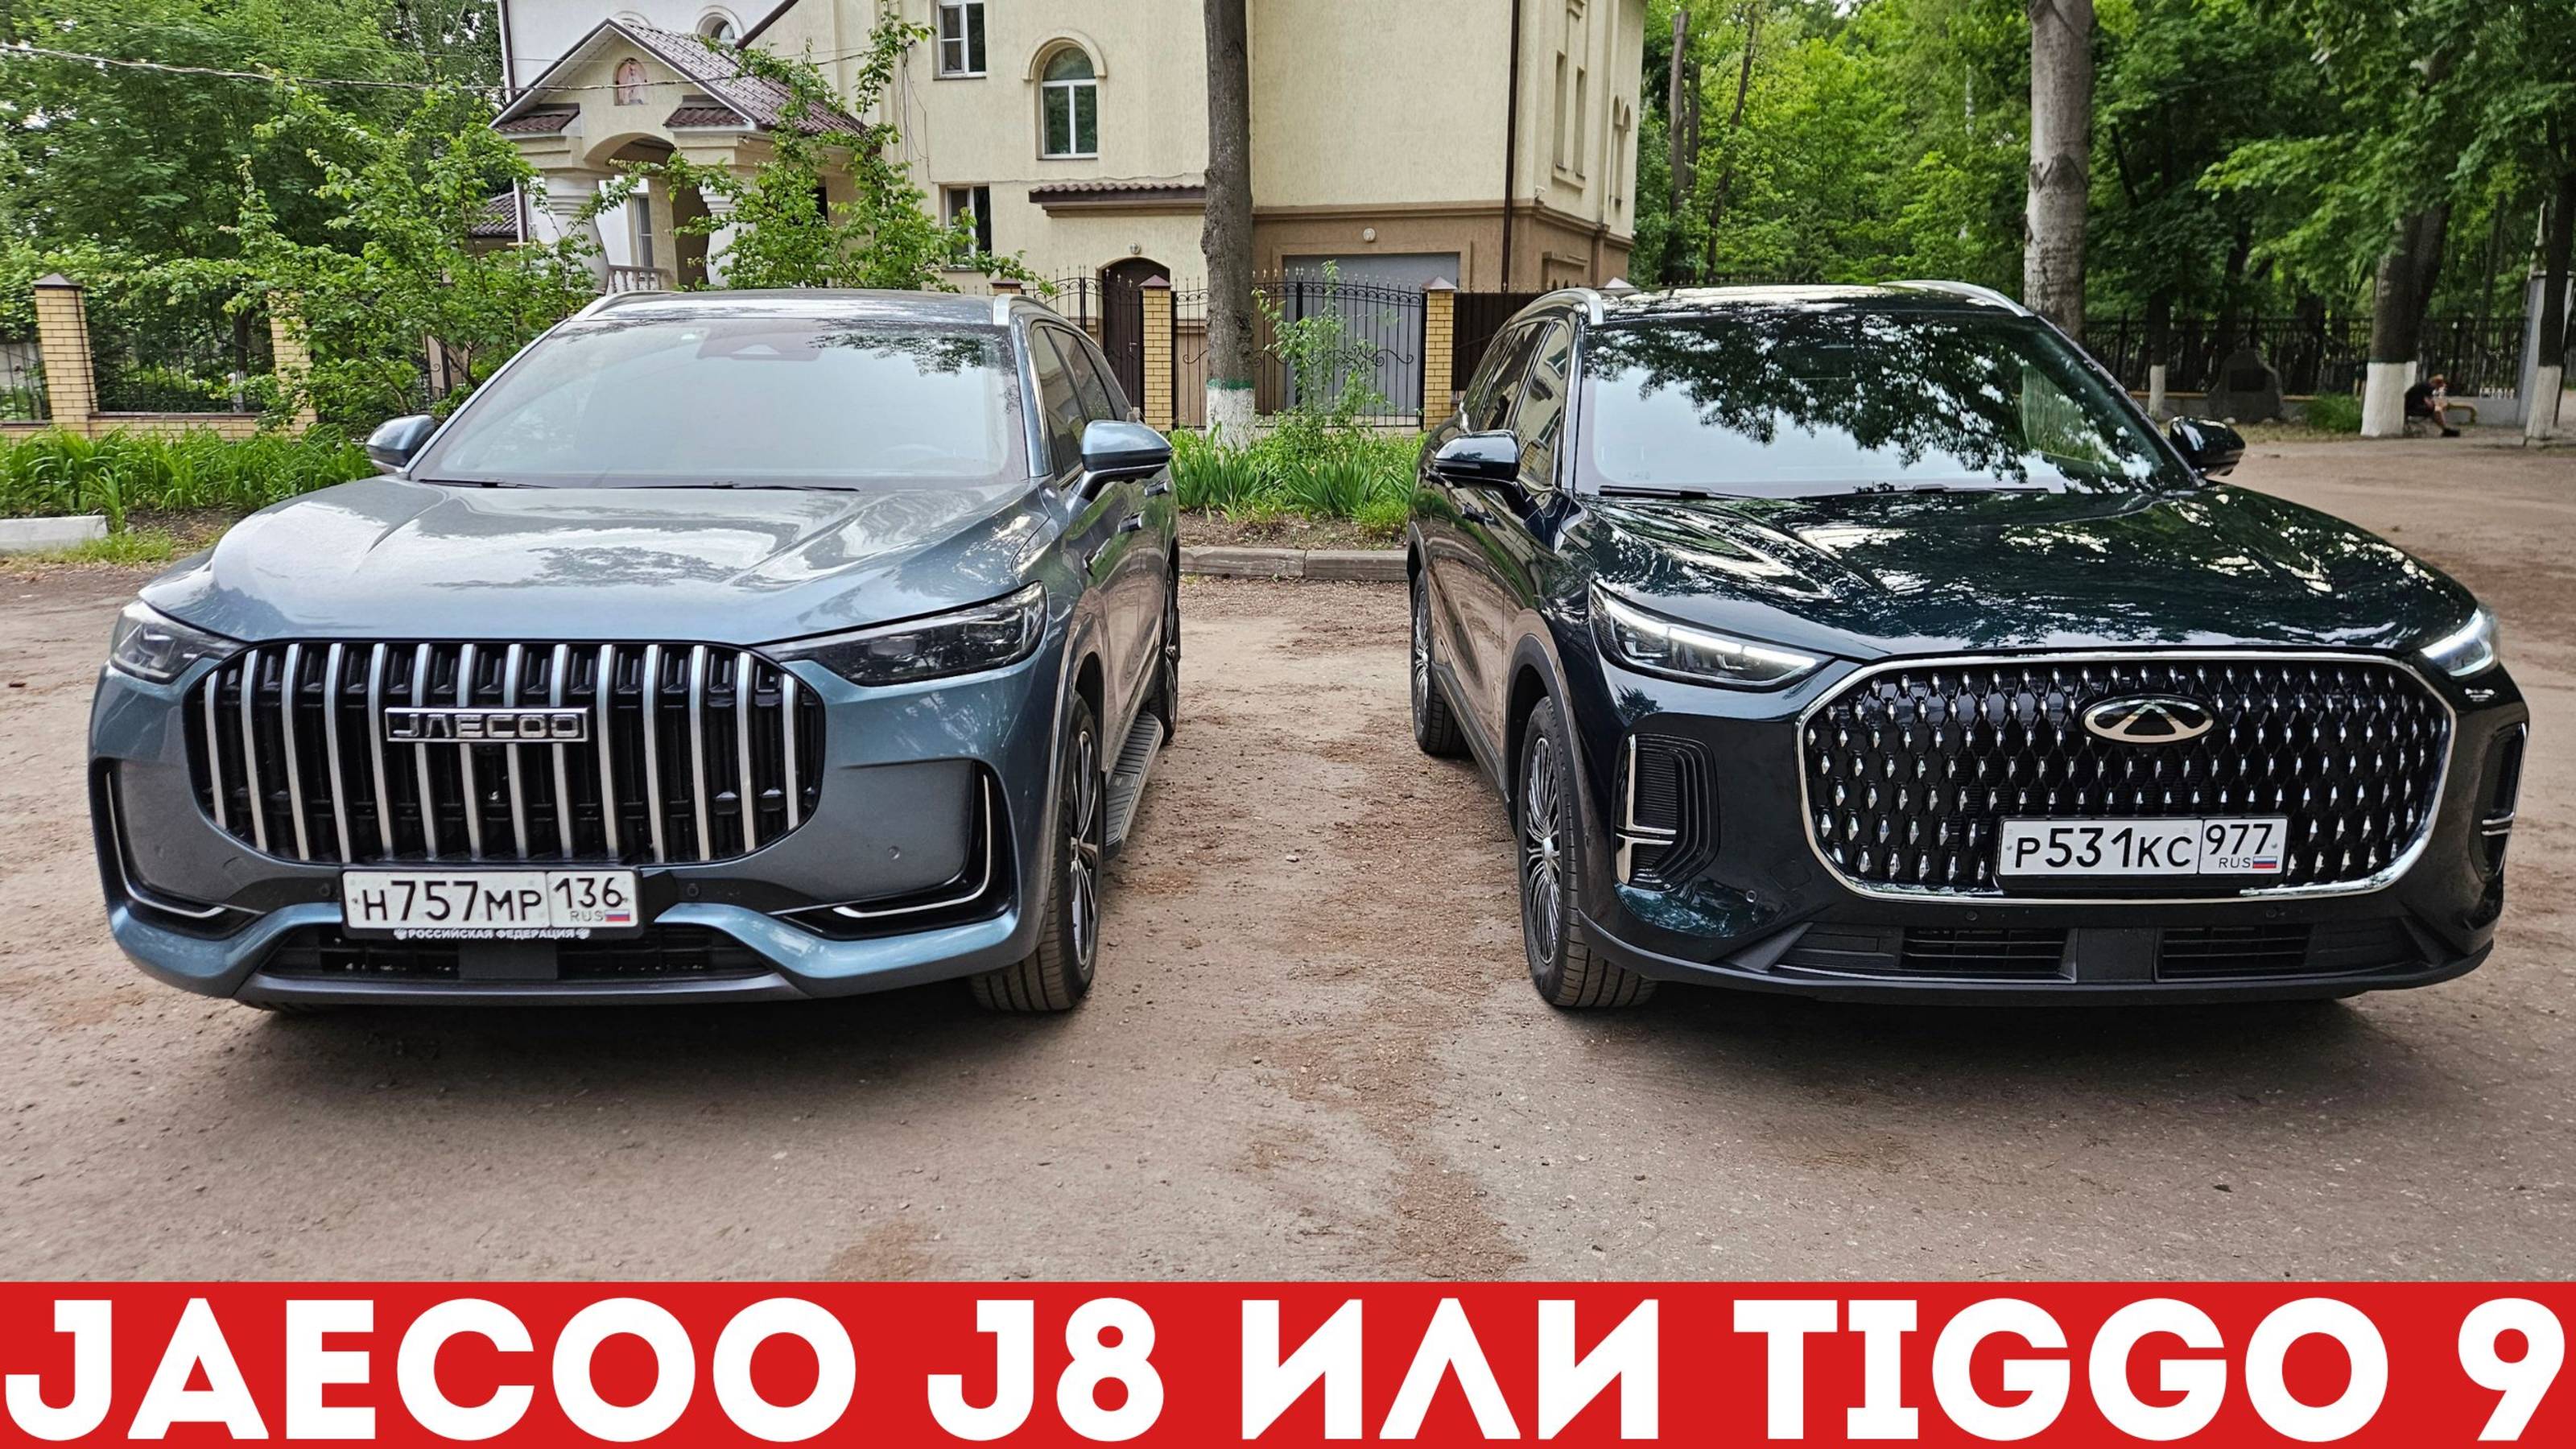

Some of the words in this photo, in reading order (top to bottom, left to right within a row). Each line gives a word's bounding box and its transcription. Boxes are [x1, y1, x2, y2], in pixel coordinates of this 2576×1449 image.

[393, 713, 579, 738] JAECOO
[2205, 823, 2273, 856] 977
[2218, 857, 2251, 869] RUS
[553, 877, 625, 909] 136
[570, 910, 604, 923] RUS
[408, 928, 493, 939] РОССИЙСКАЯ
[496, 929, 575, 940] ФЕДЕРАЦИЯ
